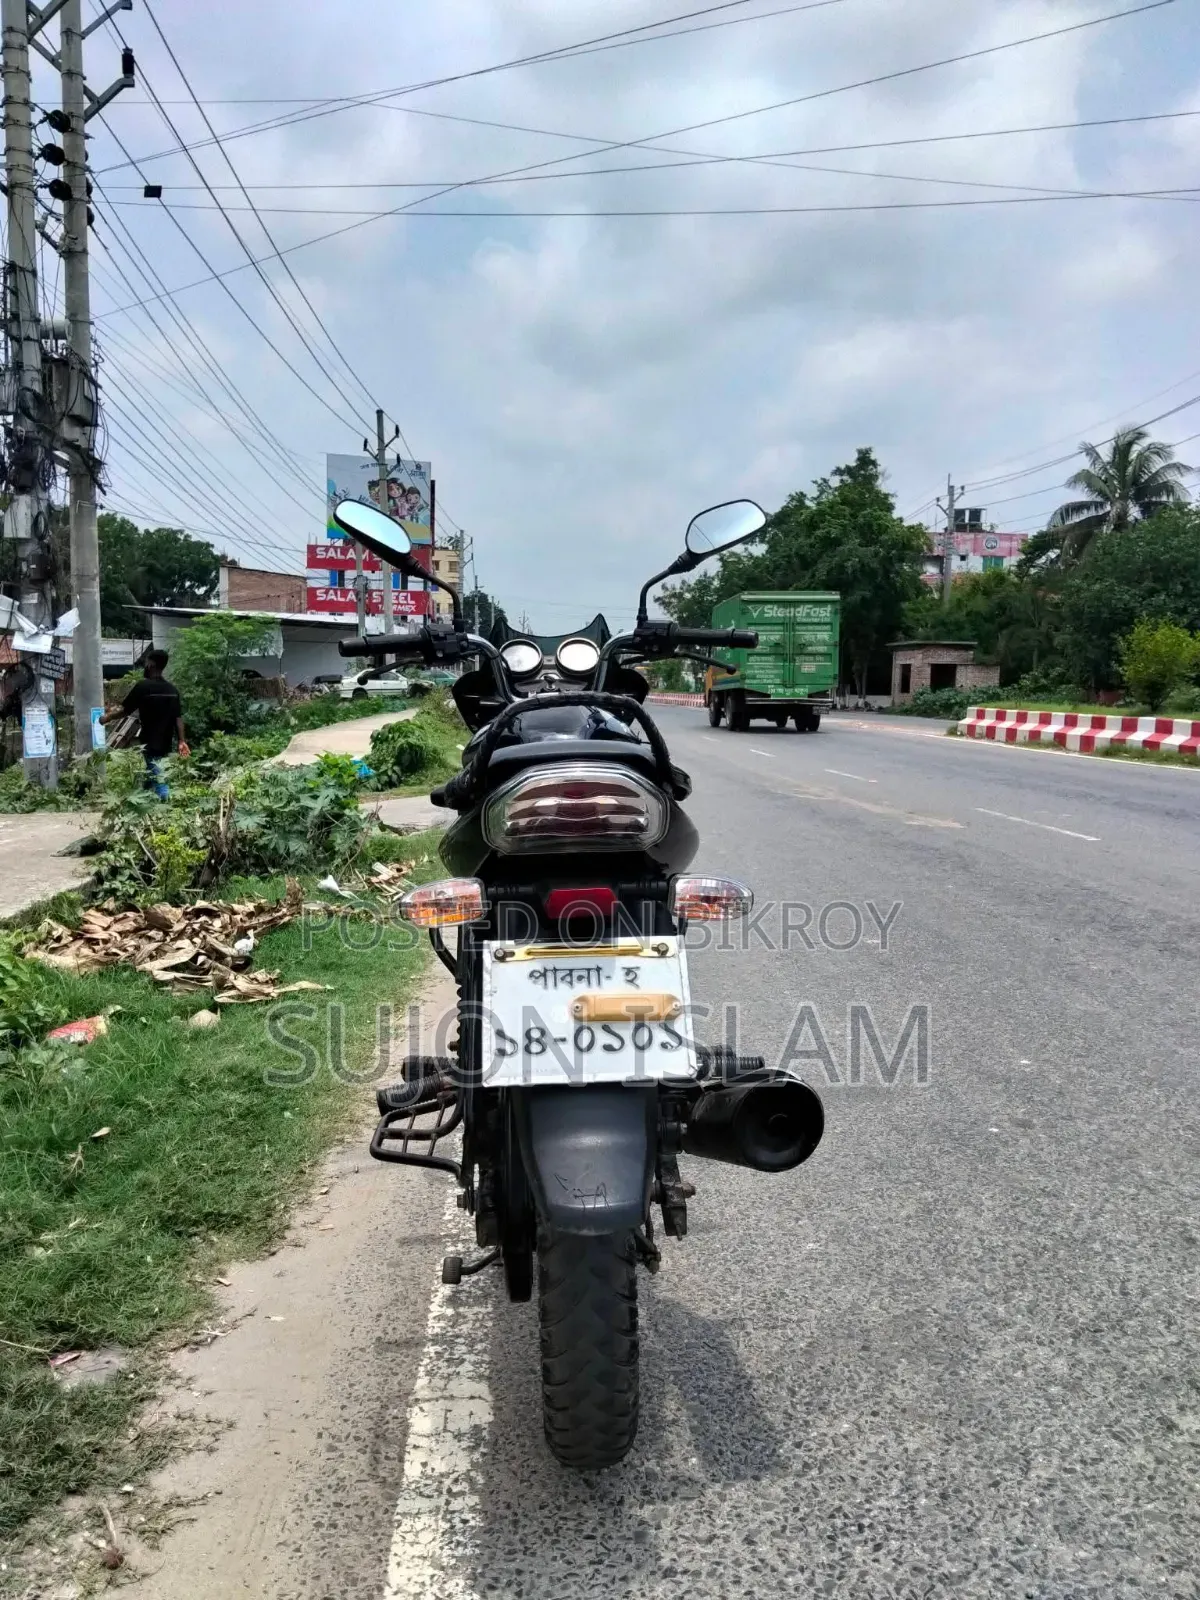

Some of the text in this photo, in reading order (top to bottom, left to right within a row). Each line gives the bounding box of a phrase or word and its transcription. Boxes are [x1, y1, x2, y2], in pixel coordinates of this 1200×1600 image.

[316, 589, 416, 604] SALA SEEL
[763, 604, 832, 617] SteadFast
